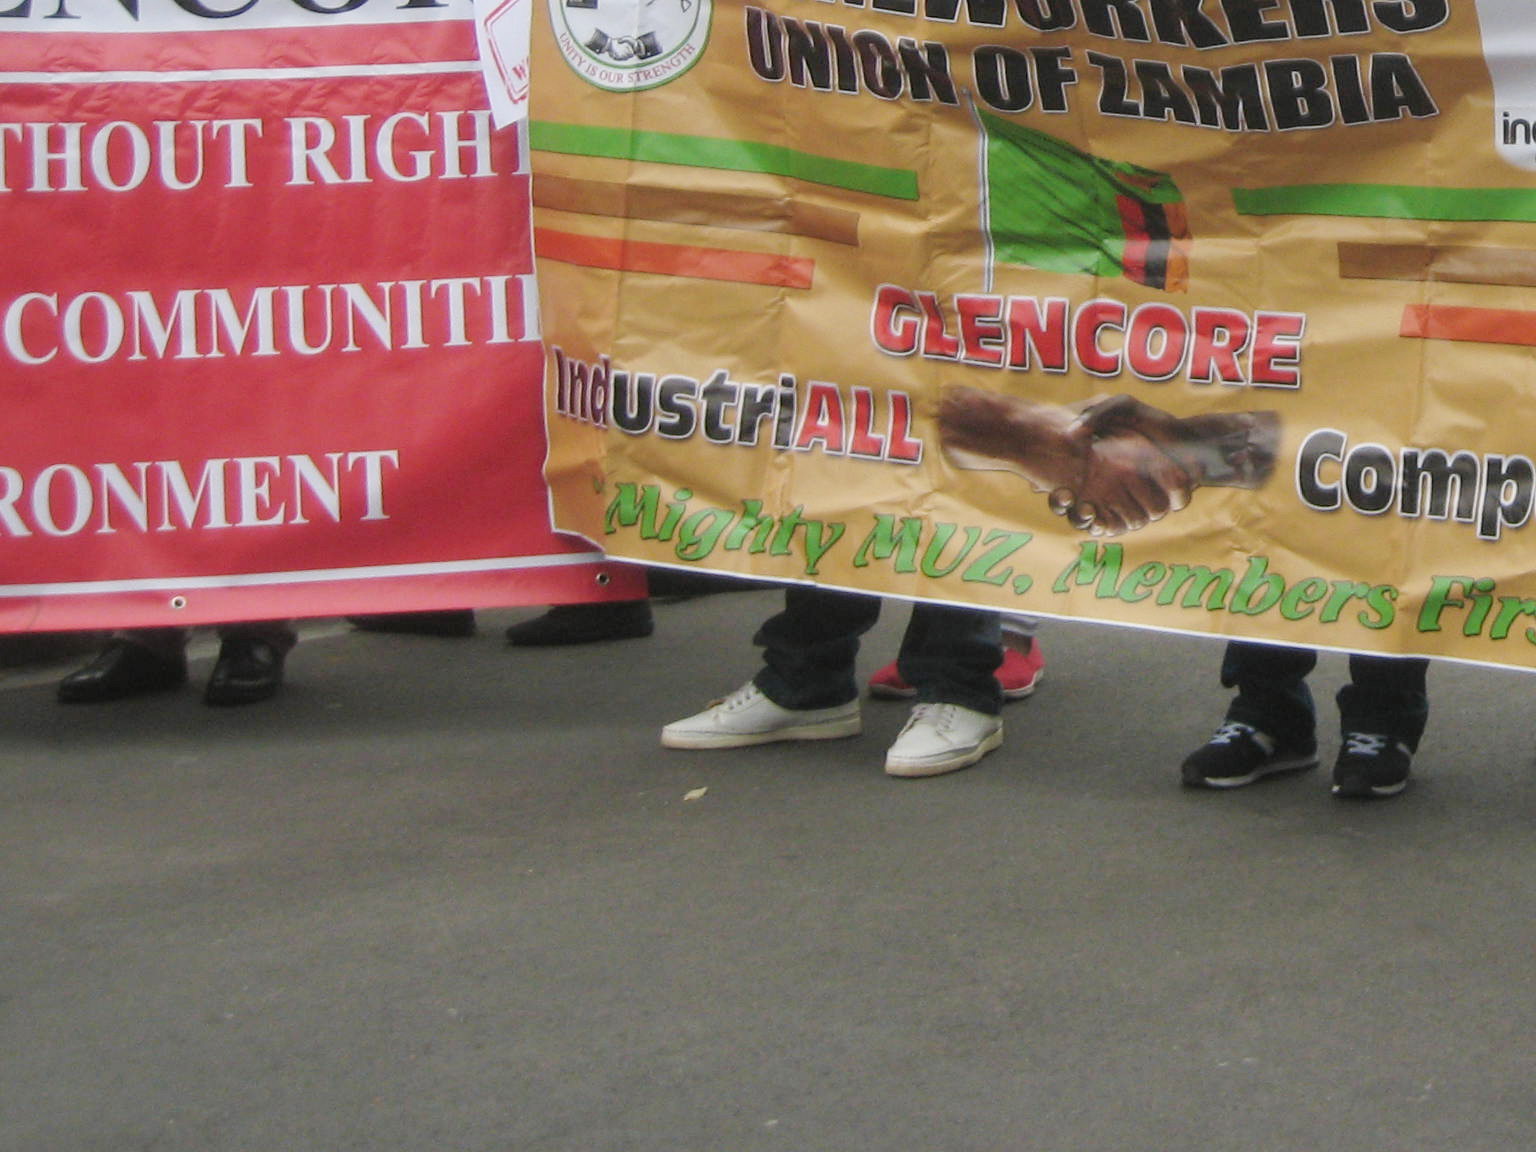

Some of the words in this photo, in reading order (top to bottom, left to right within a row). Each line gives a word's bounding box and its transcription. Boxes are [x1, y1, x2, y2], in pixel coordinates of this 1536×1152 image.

[559, 31, 586, 67] UNITY
[585, 63, 598, 76] IS
[599, 69, 624, 84] OUR
[627, 44, 695, 84] STRENGTH
[745, 5, 960, 106] UNION
[971, 45, 1079, 114] OF
[1085, 51, 1440, 132] ZAMBIA
[869, 283, 1306, 389] GLENCORE
[551, 345, 923, 465] IndustriALL
[853, 512, 1035, 596] MUZ,
[1053, 540, 1399, 630] Members
